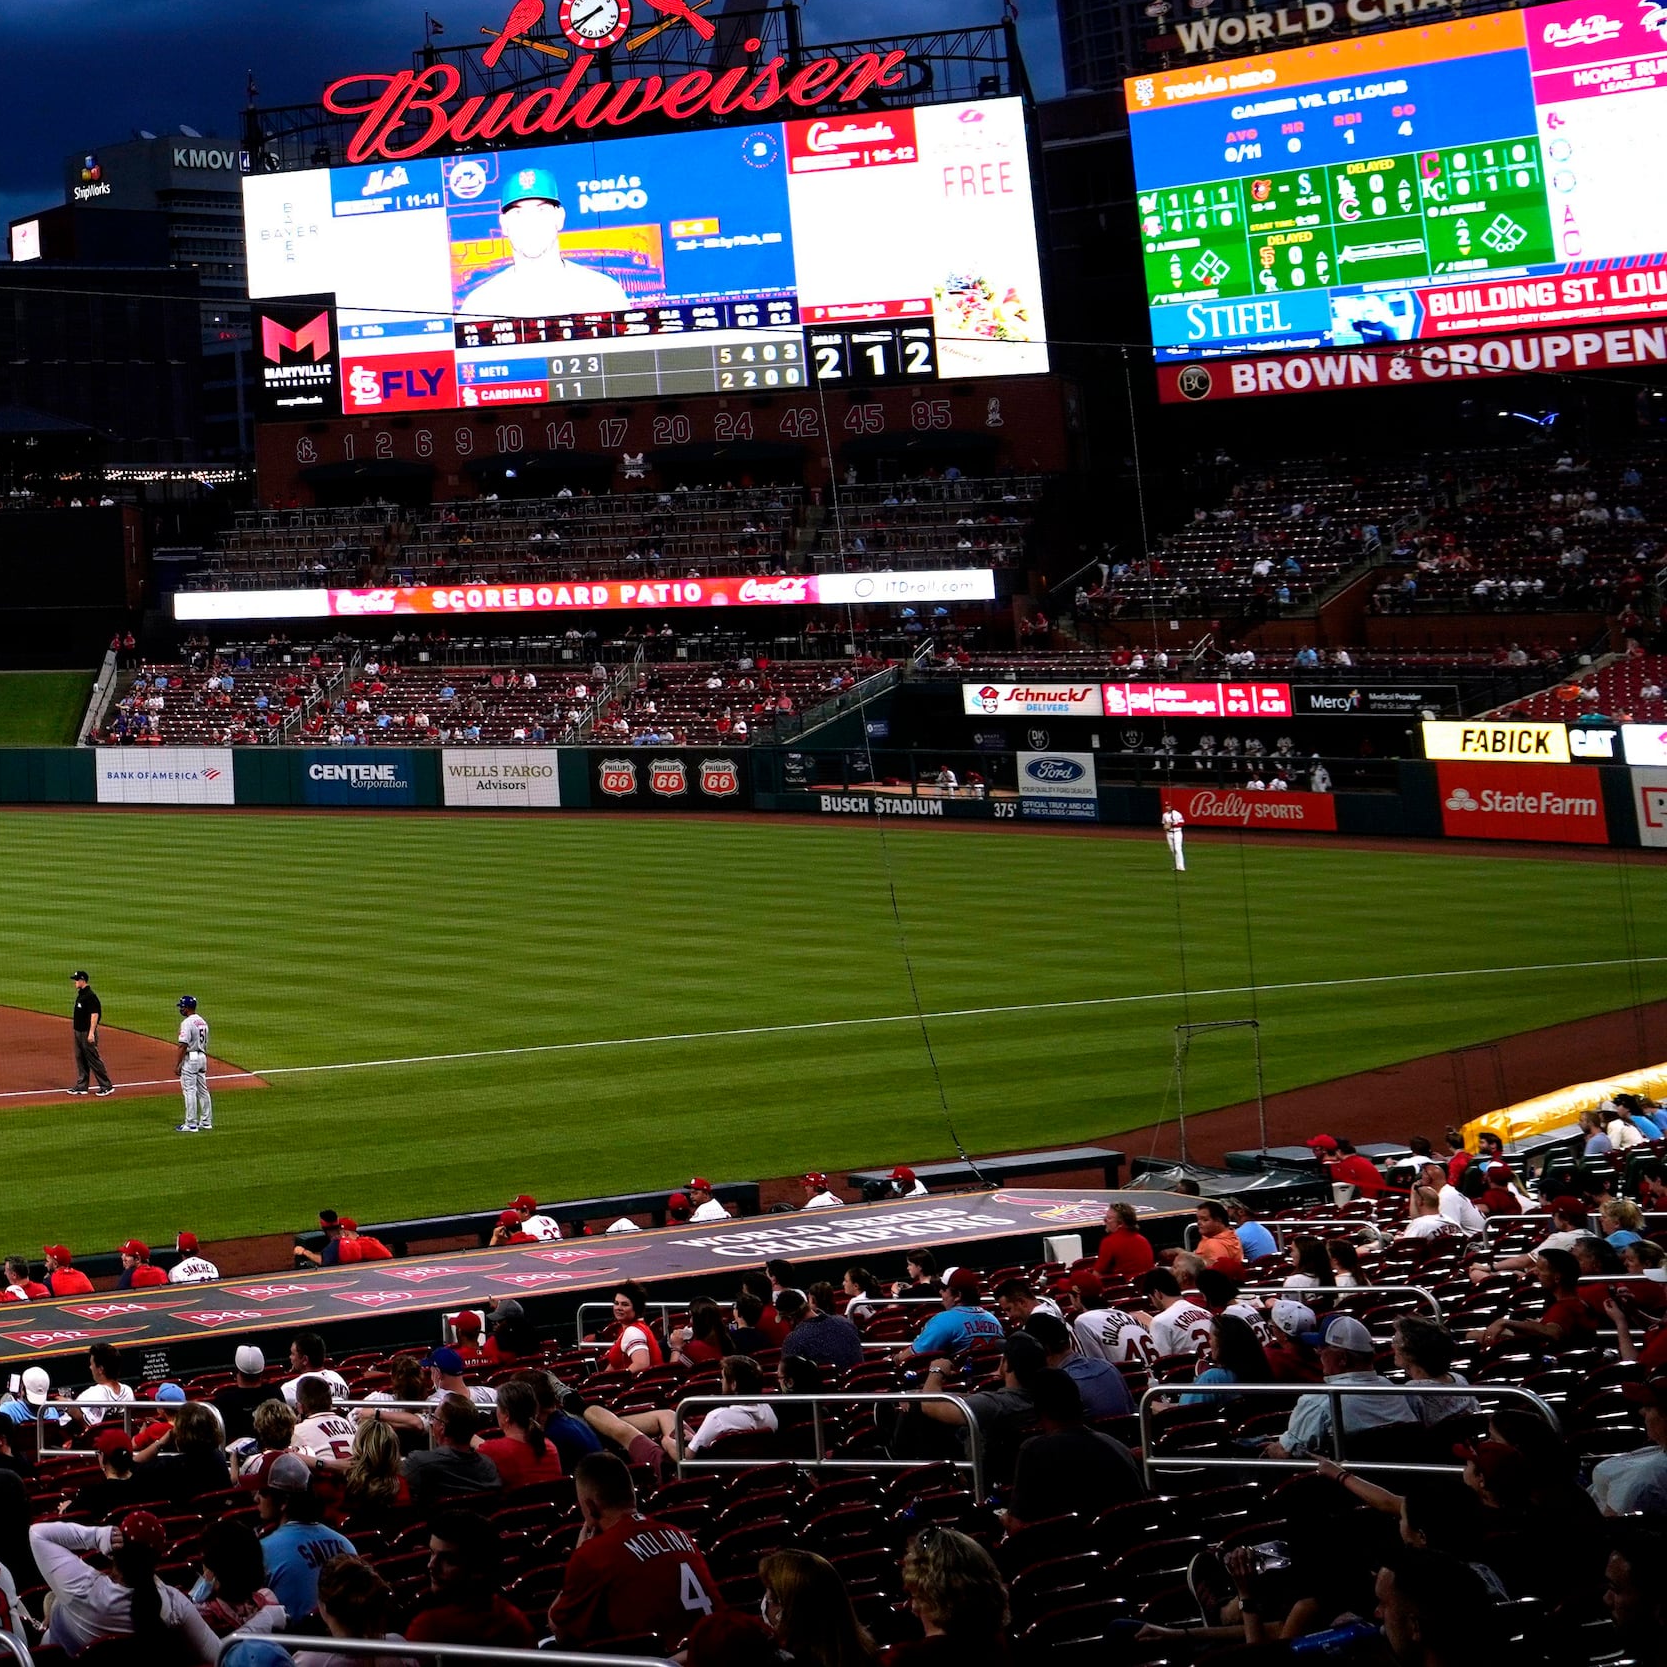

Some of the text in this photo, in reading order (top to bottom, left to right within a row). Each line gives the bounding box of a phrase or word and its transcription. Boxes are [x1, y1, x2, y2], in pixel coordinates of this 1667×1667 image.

[1175, 3, 1335, 54] WORLD
[322, 37, 906, 164] Budweiser
[173, 148, 235, 170] KMOV
[74, 182, 110, 201] ShipWorks
[577, 174, 642, 193] TOMÁS
[943, 161, 1014, 197] FREE
[579, 188, 649, 214] NIDO
[1428, 281, 1559, 318] BUILDING
[1561, 278, 1605, 305] ST.
[1186, 302, 1292, 341] STIFEL
[264, 364, 332, 379] MARYVILLE
[479, 365, 509, 378] METS
[1231, 328, 1667, 394] BROWN & CROUPPEN
[382, 368, 446, 398] FLY
[481, 385, 542, 401] CARDINALS
[713, 412, 755, 442] 24
[779, 408, 820, 438] 42
[844, 404, 886, 434] 45
[911, 400, 953, 430] 85
[496, 425, 524, 453] 10
[547, 421, 577, 449] 14
[599, 418, 628, 448] 17
[652, 415, 692, 445] 20
[432, 579, 704, 610] SCOREBOARD PATIO
[1026, 704, 1069, 713] DELIVERS
[1311, 694, 1352, 711] Mercy
[1461, 729, 1617, 757] FABICK CAT
[107, 770, 198, 781] BANK OF AMERICA
[308, 763, 396, 781] CENTENE
[351, 777, 409, 791] Corporation
[447, 765, 553, 779] WELLS FARGO
[606, 774, 629, 788] 66
[656, 774, 679, 788] 66
[706, 774, 730, 788] 66
[1038, 761, 1074, 781] Ford
[475, 779, 527, 792] Advisors
[821, 795, 944, 816] BUSCH STADIUM
[993, 802, 1017, 818] 375'
[1189, 791, 1304, 821] Bally SPORTS
[668, 1207, 970, 1250] WORLD SERIES
[711, 1214, 1017, 1258] CHAMPIONS
[242, 1283, 309, 1296] 1964
[503, 1270, 574, 1284] 2006
[80, 1301, 149, 1317] 1944
[190, 1309, 263, 1322] 1946
[1124, 1335, 1159, 1365] 46
[623, 1529, 696, 1562] MOLINA
[679, 1562, 713, 1616] 4
